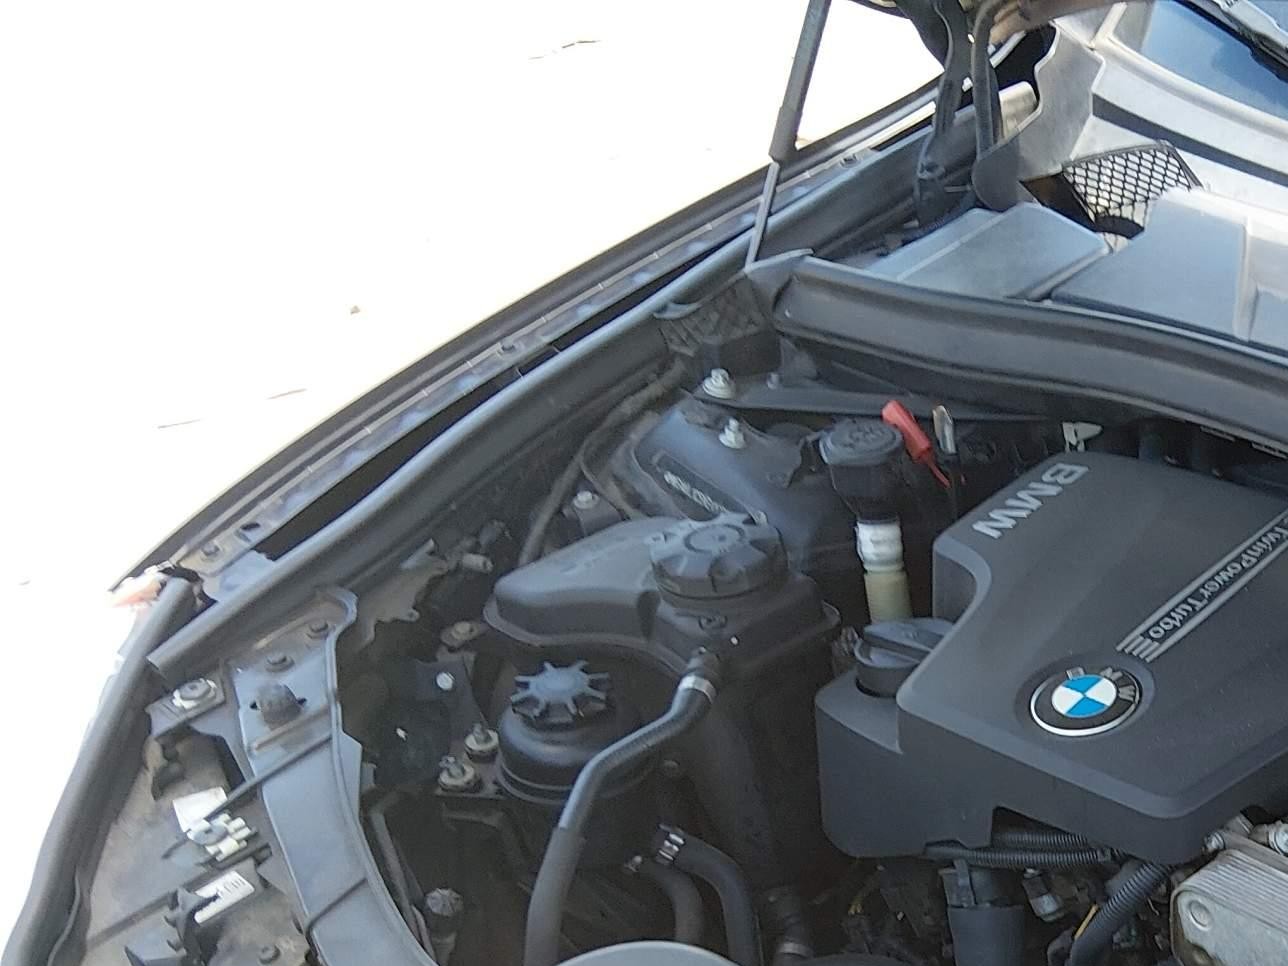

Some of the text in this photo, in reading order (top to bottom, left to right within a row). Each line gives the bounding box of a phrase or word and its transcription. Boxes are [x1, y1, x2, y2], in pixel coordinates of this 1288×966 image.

[972, 463, 1089, 539] BMW
[1149, 596, 1209, 639] Turbo
[1066, 666, 1136, 701] BMW
